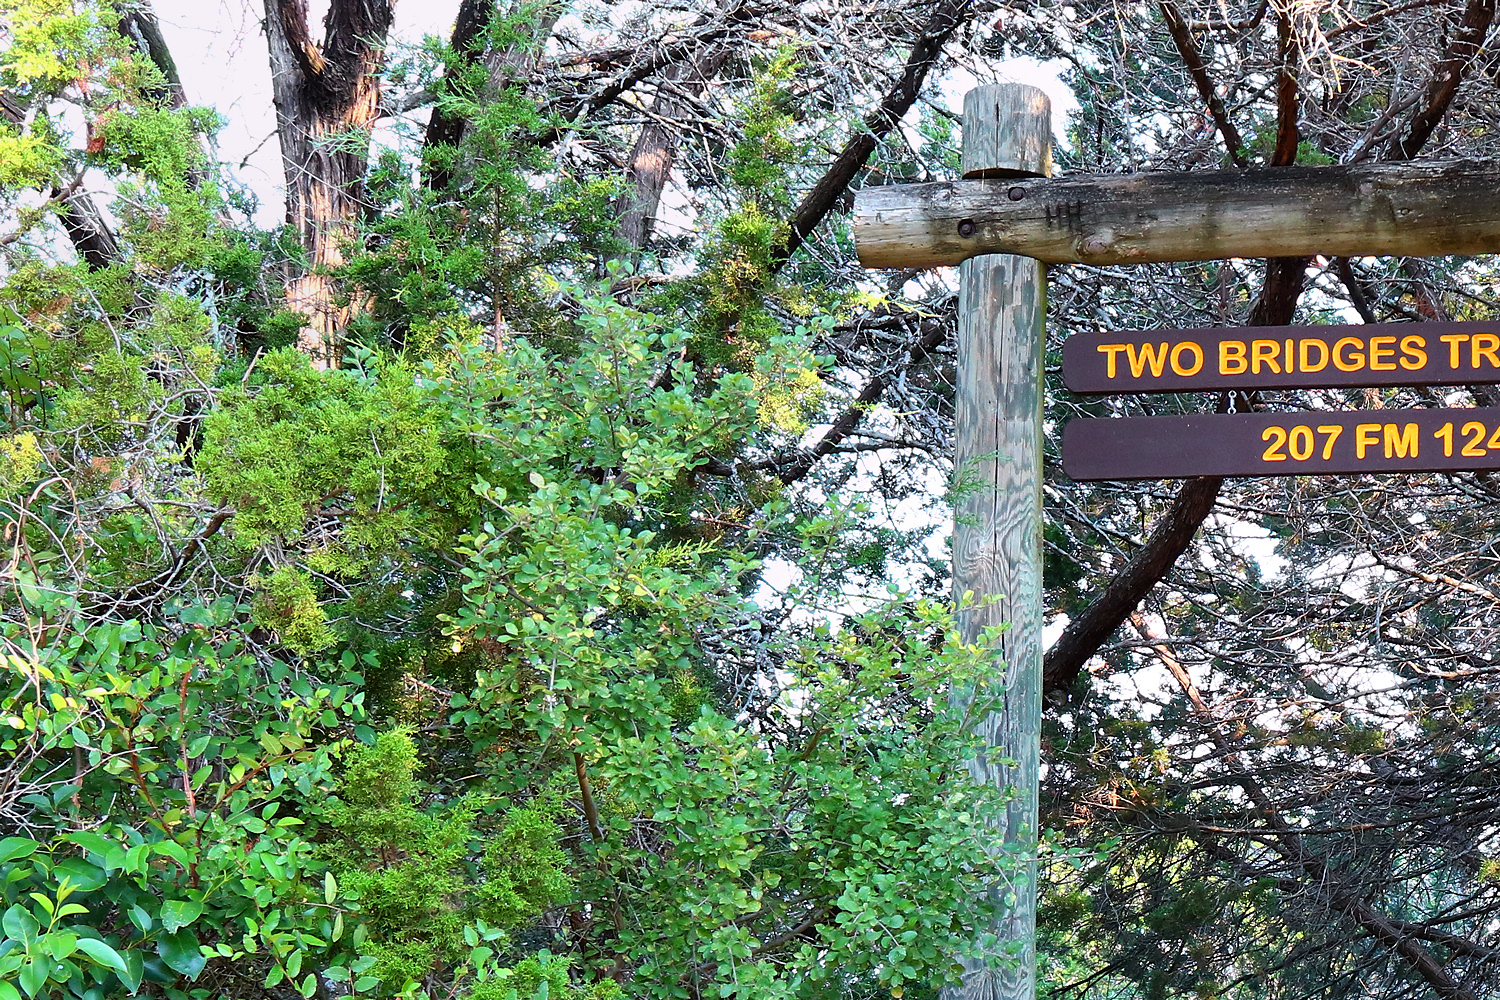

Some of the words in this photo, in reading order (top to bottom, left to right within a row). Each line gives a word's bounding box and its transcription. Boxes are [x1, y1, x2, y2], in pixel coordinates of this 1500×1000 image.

[1097, 341, 1204, 378] TWO
[1218, 335, 1428, 374] BRIDGES
[1262, 424, 1343, 461] 207
[1356, 422, 1419, 458] FM
